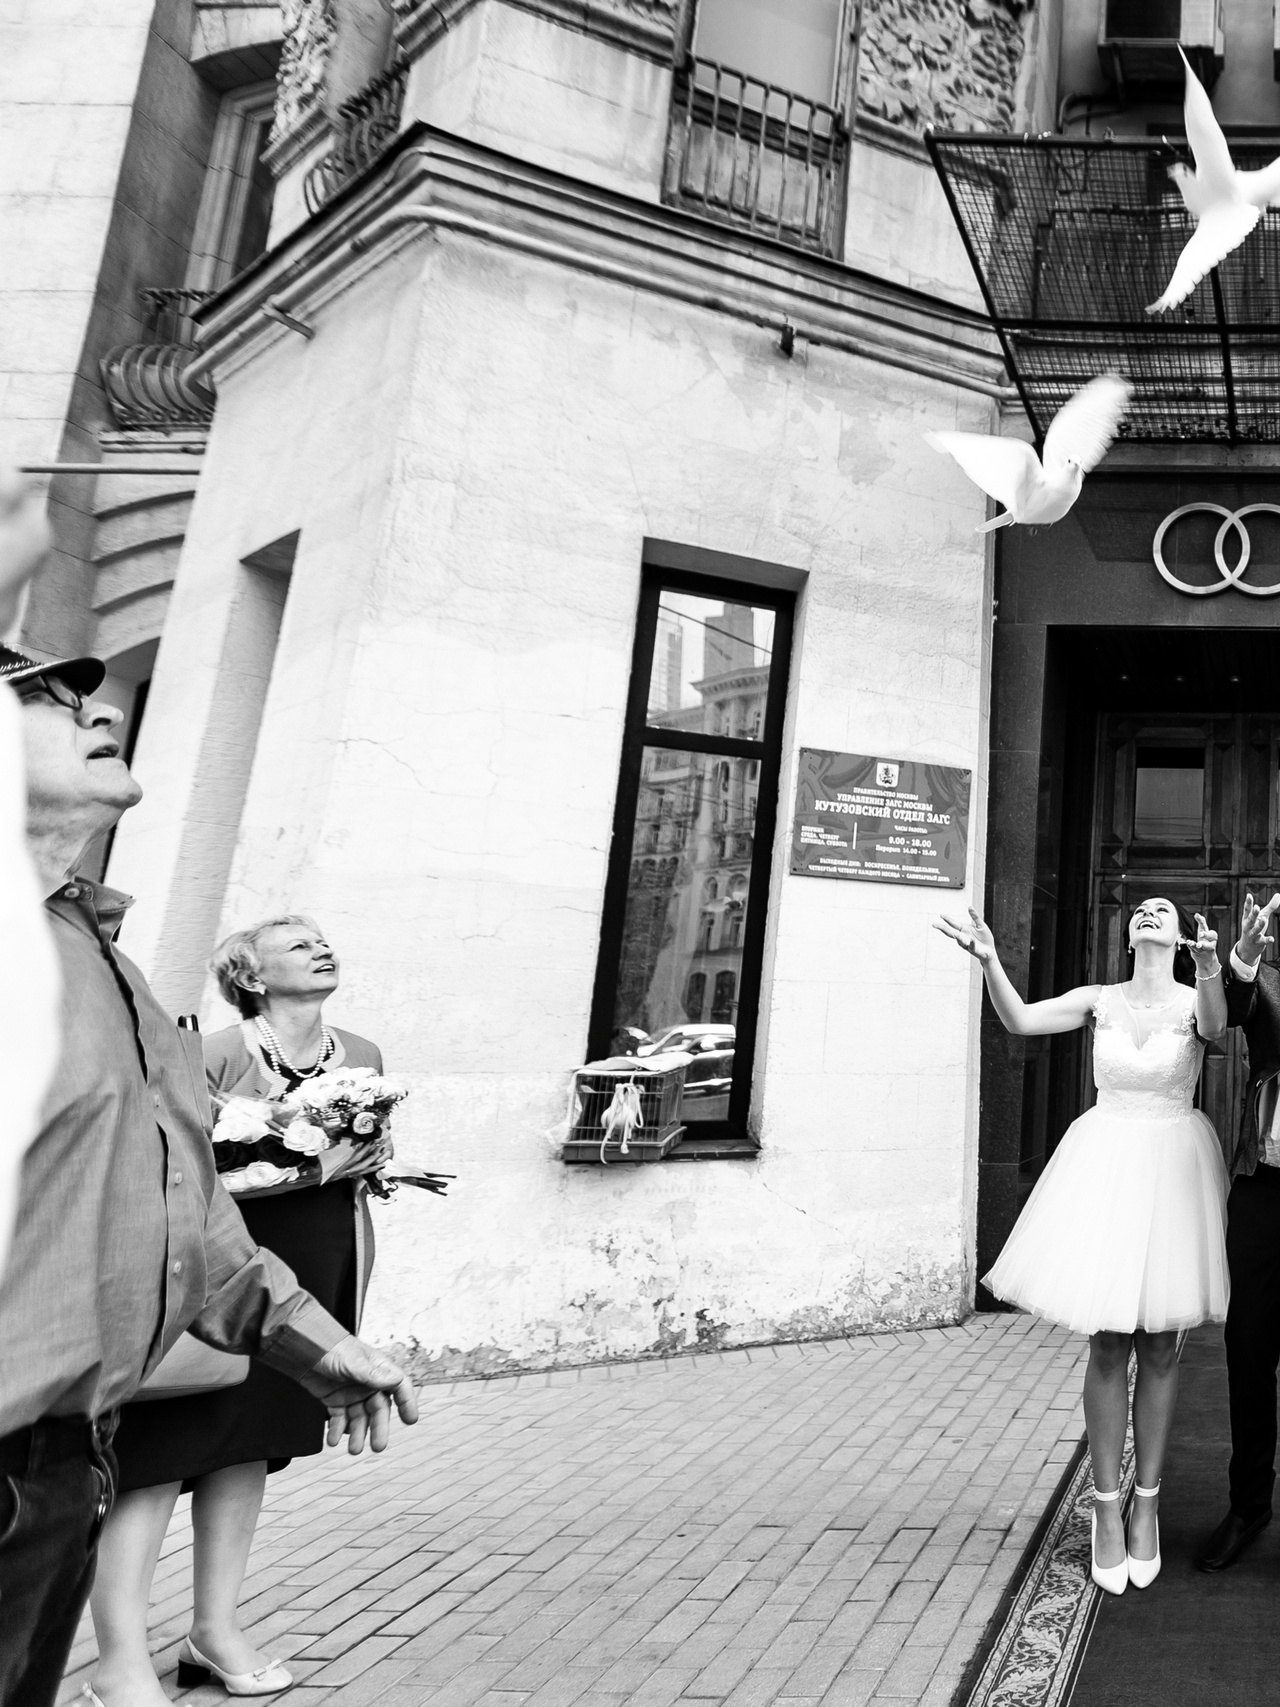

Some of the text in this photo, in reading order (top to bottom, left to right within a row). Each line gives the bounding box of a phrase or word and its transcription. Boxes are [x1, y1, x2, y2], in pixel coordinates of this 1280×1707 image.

[853, 787, 919, 800] ПРАВИТЕЛЬСТВО МОСКВЫ
[837, 793, 933, 811] УПРАВЛЕНИЕ ЗАГС МОСКВЫ
[815, 799, 951, 825] КУТУЗОВСКИЙ ОТДЕЛ ЗАГС
[826, 839, 848, 847] СУББОТА
[888, 836, 905, 846] 9.00
[911, 838, 932, 848] 18.00
[875, 844, 901, 853] Перерыв
[902, 847, 918, 855] 14.00
